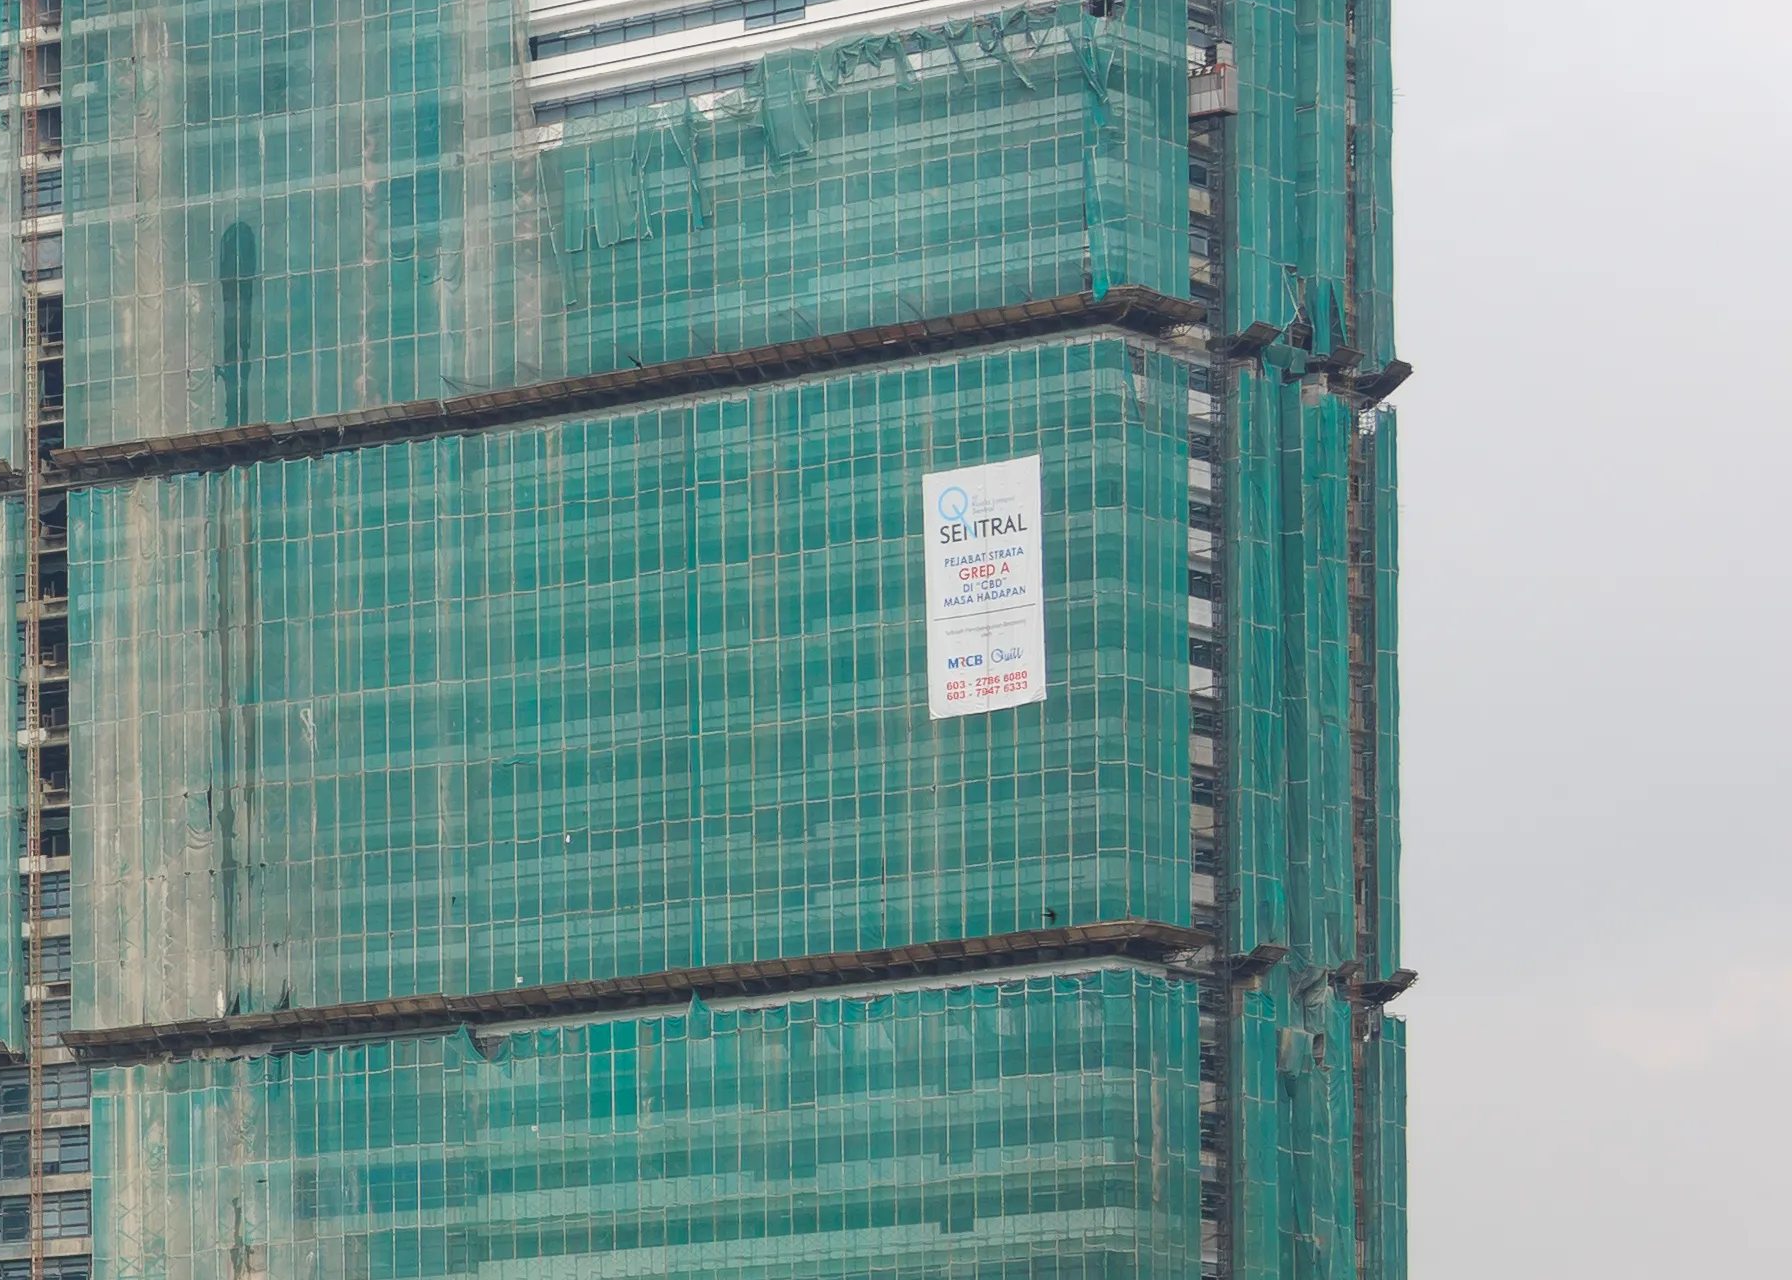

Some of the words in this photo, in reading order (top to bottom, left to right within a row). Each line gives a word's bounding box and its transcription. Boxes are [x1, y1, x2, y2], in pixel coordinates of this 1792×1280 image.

[940, 513, 1028, 545] SENTRAL
[944, 552, 986, 568] PEJABAT
[988, 546, 1024, 561] STRATA
[958, 563, 996, 580] GRED
[1000, 561, 1010, 575] A
[943, 595, 974, 608] MASA
[976, 585, 1026, 602] HADAPAN
[963, 583, 973, 593] DI
[947, 654, 983, 669] MRCB
[990, 647, 1024, 663] Quill
[946, 680, 966, 691] 603
[975, 675, 1000, 687] 2786
[1003, 670, 1028, 682] 6080
[946, 691, 966, 701] 603
[975, 686, 1000, 697] 7947
[1003, 681, 1028, 692] 6333
